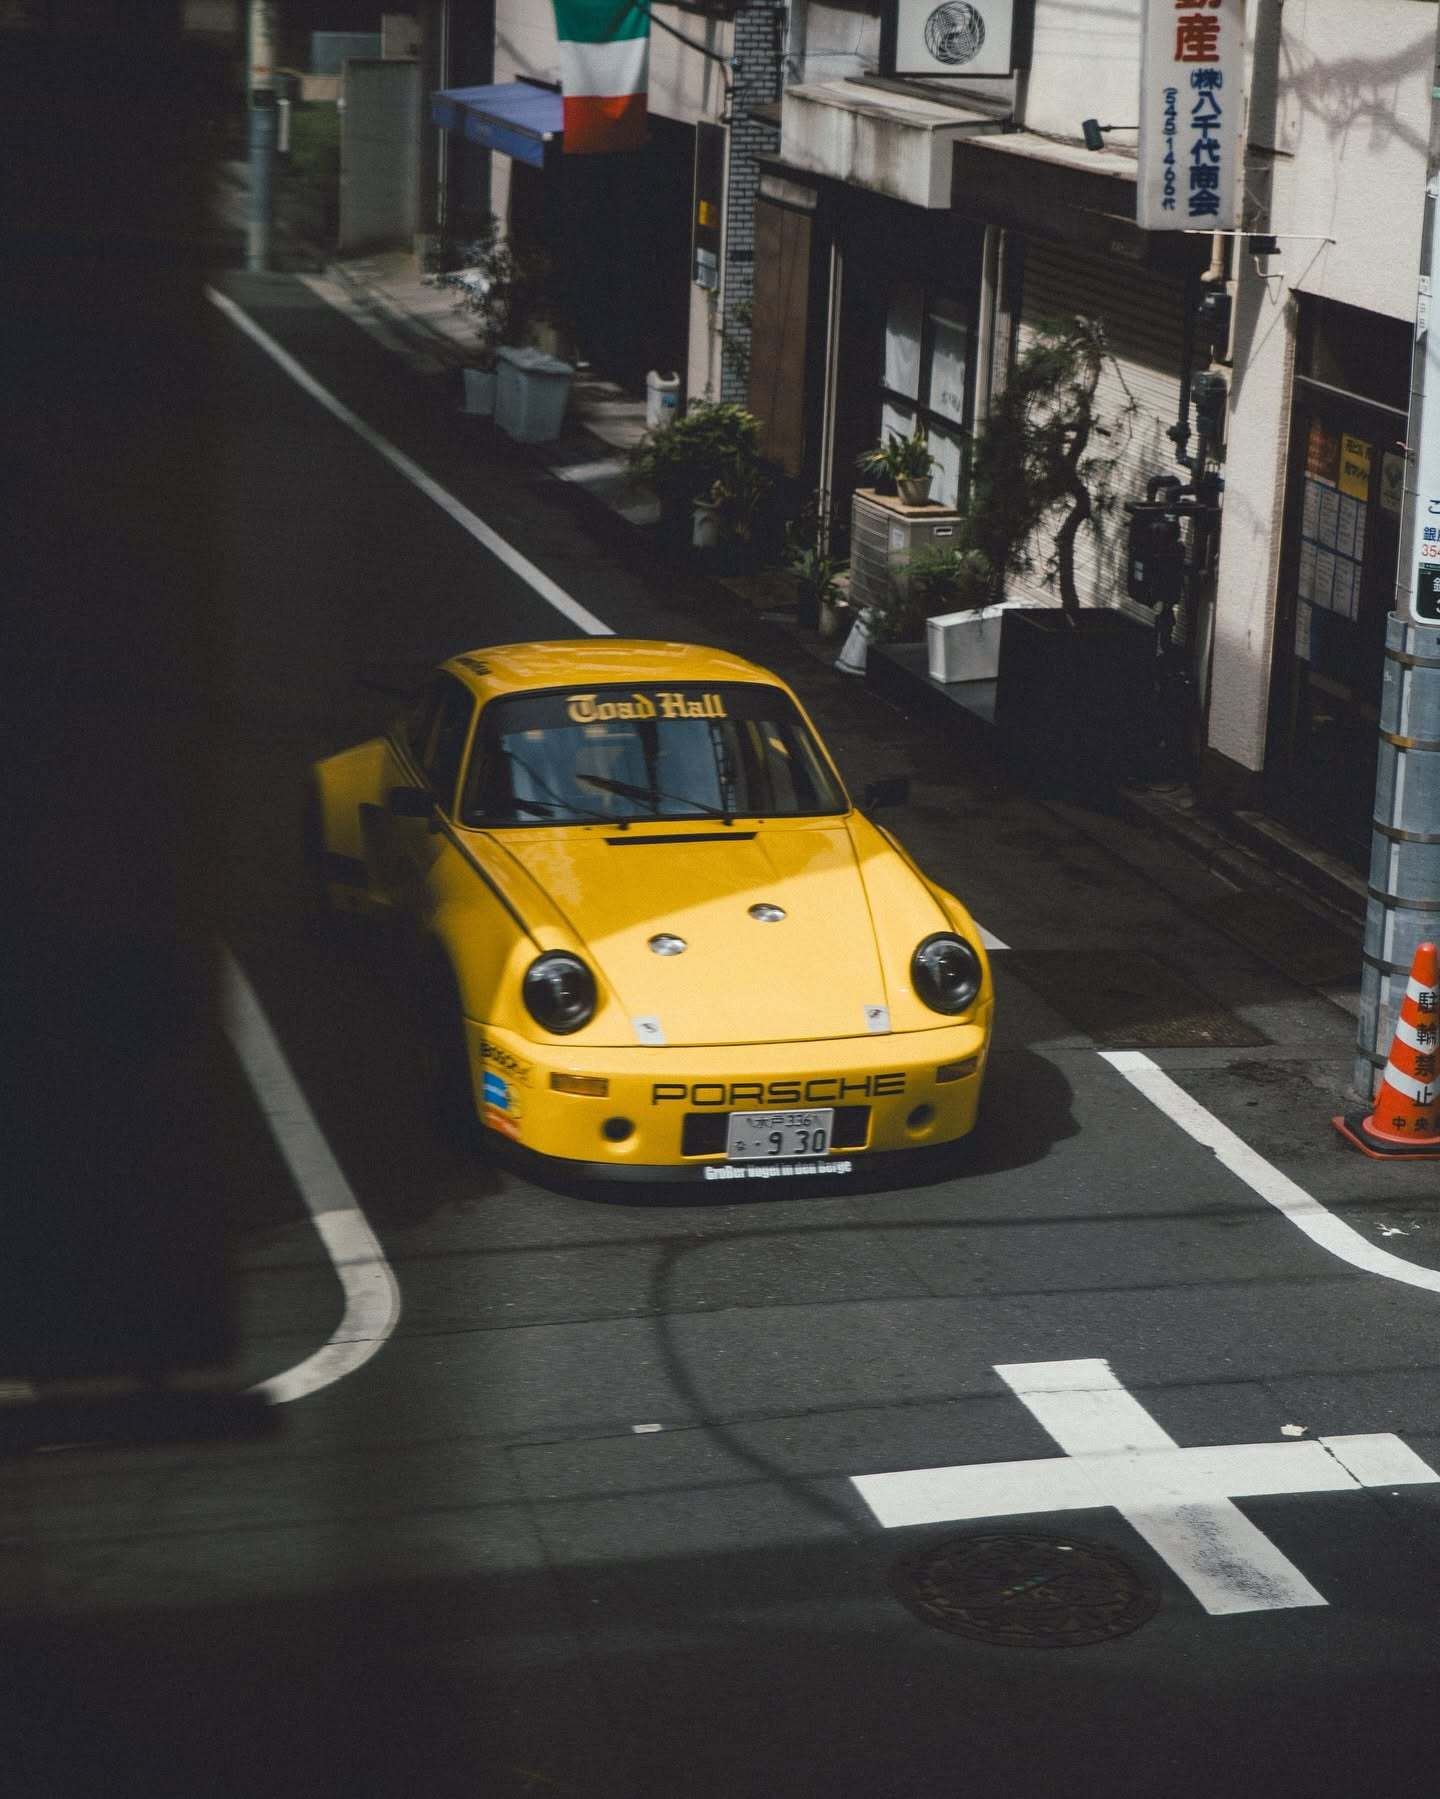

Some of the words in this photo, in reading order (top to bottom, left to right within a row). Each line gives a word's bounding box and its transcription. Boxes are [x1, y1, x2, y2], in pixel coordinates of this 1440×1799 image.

[1174, 0, 1221, 62] 産
[565, 693, 657, 723] Toad
[655, 692, 728, 719] Hall
[652, 1072, 906, 1105] PORSCHE
